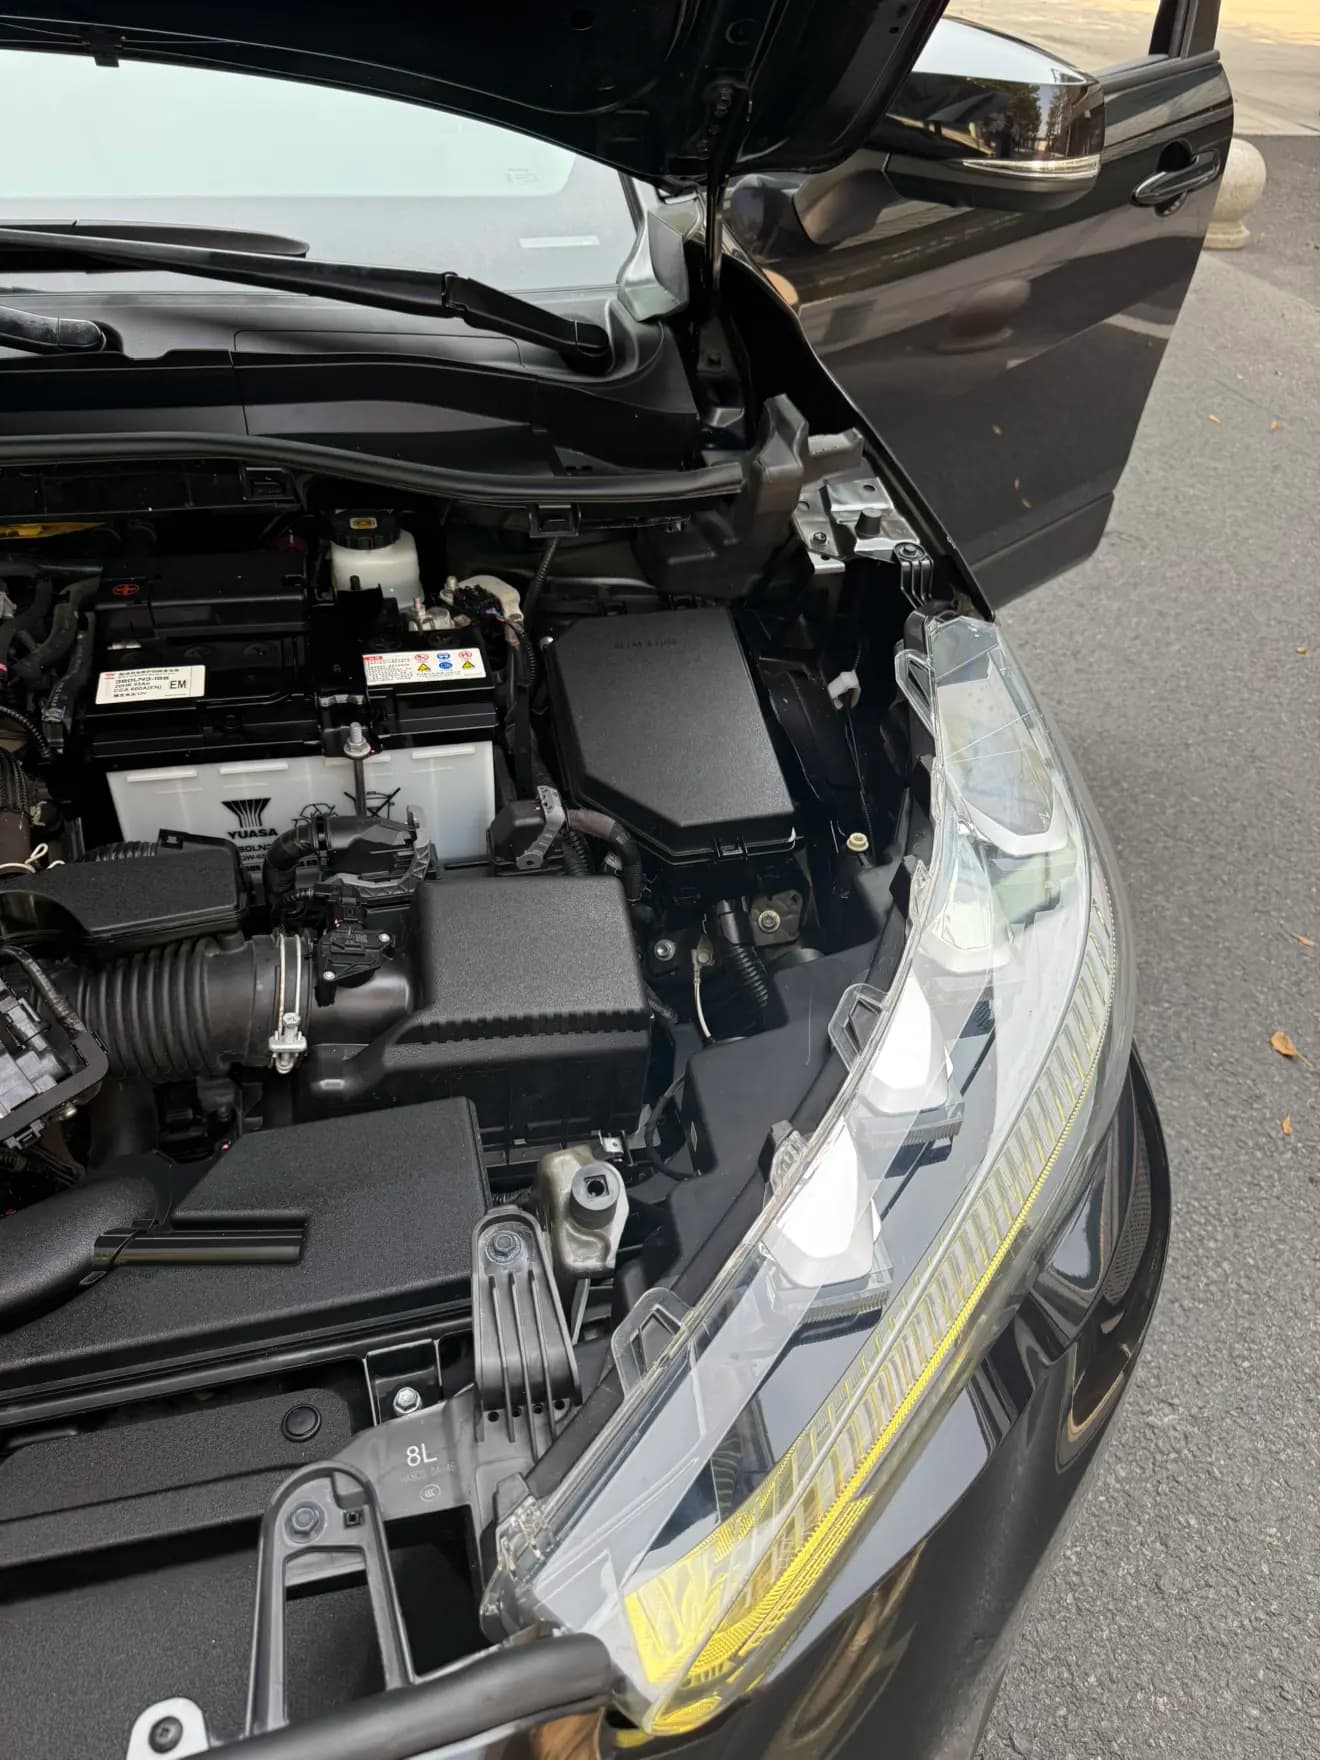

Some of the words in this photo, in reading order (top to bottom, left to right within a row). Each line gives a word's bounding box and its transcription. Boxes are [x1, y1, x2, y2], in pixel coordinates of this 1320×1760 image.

[170, 680, 187, 689] EM
[227, 828, 278, 839] YUASA
[406, 1443, 437, 1467] 8L
